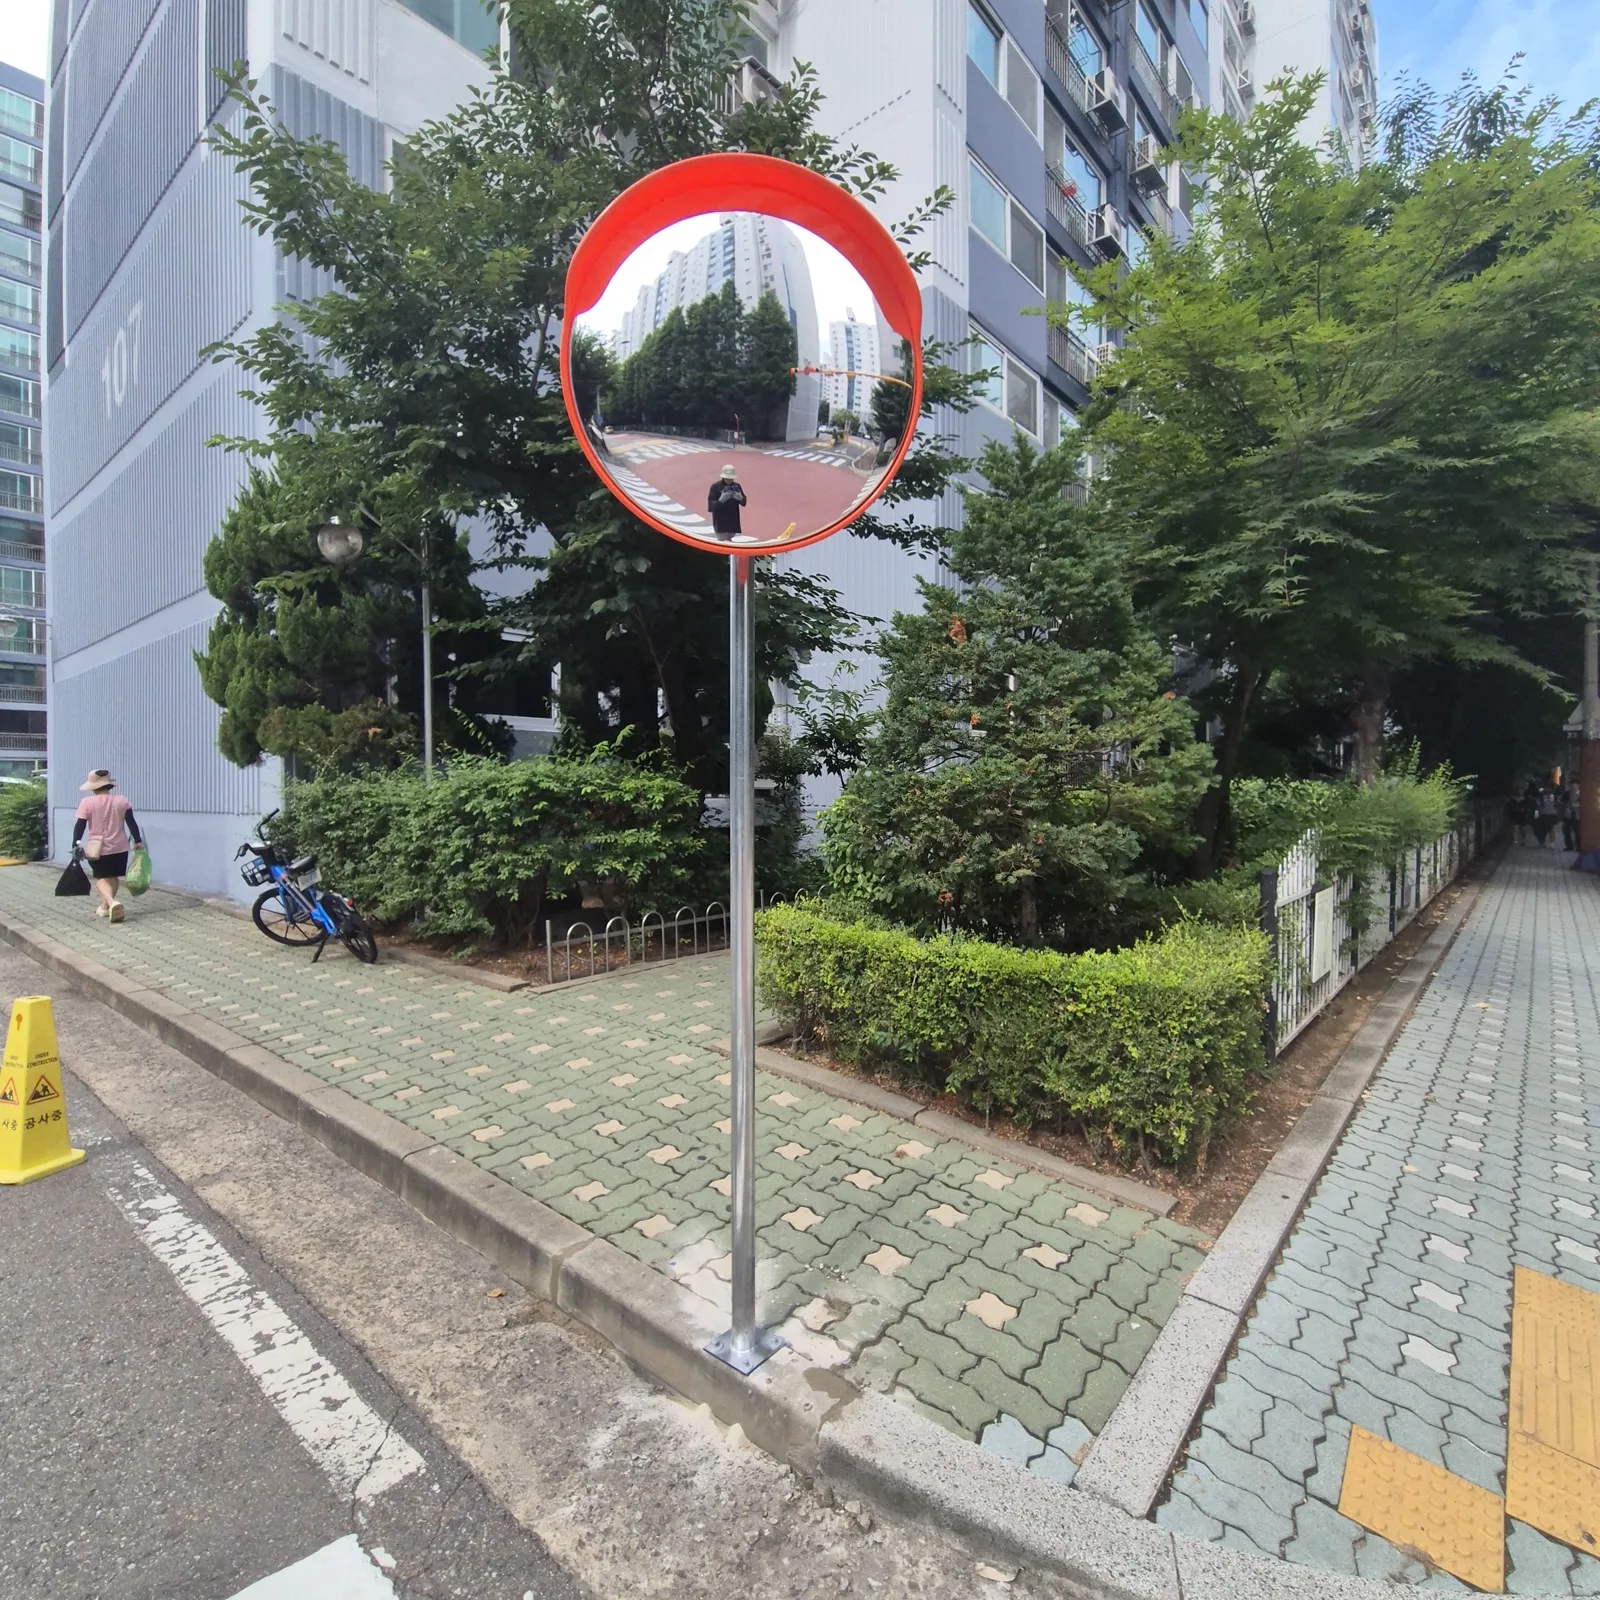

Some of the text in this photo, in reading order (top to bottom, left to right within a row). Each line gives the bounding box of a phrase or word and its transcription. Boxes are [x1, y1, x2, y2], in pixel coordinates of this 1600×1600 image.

[101, 298, 143, 419] 107
[27, 1056, 58, 1068] CONSTRUCTION
[34, 1051, 49, 1059] UNDER
[24, 1109, 63, 1130] 공사중
